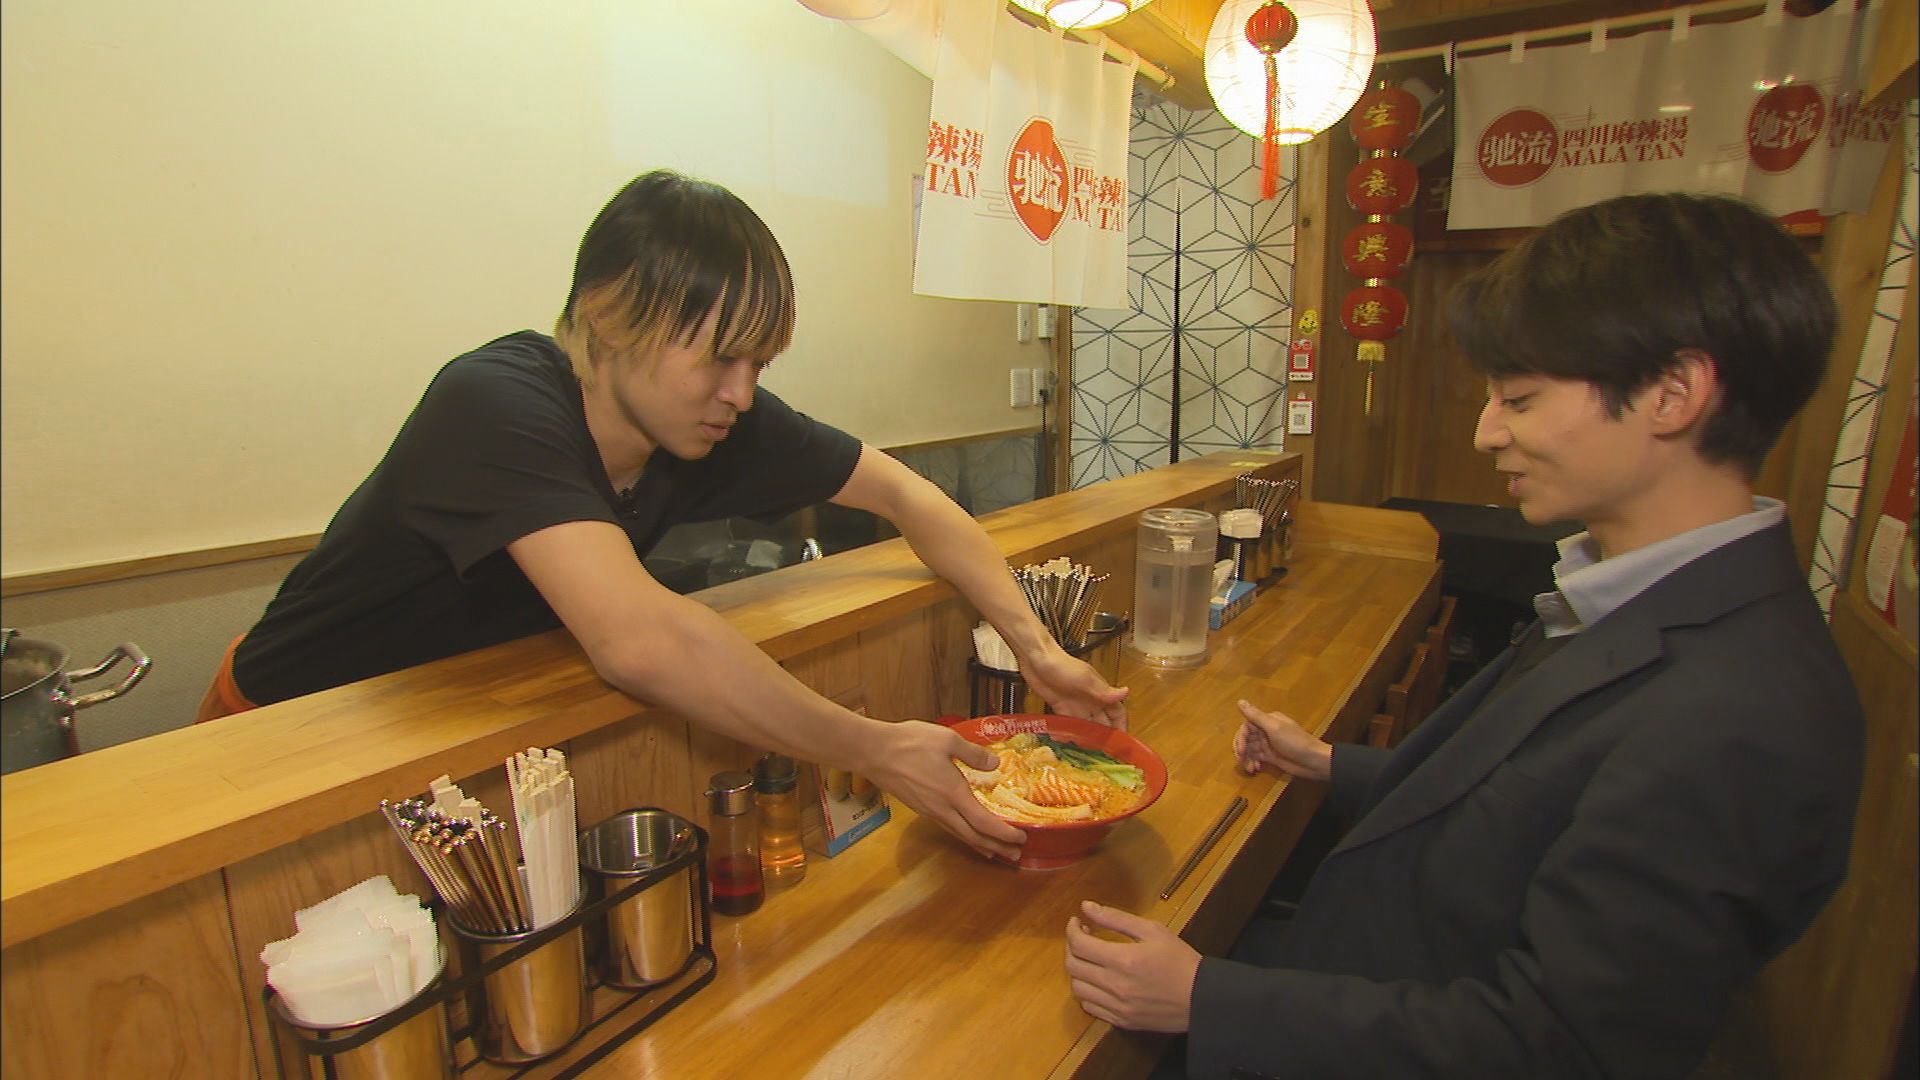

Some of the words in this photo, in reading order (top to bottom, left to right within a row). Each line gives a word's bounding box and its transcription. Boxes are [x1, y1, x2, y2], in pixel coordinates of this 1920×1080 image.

[1563, 115, 1688, 148] 四川麻辣湯
[1483, 131, 1553, 168] 驰流
[1560, 145, 1628, 168] MALA
[1635, 140, 1688, 162] TAN
